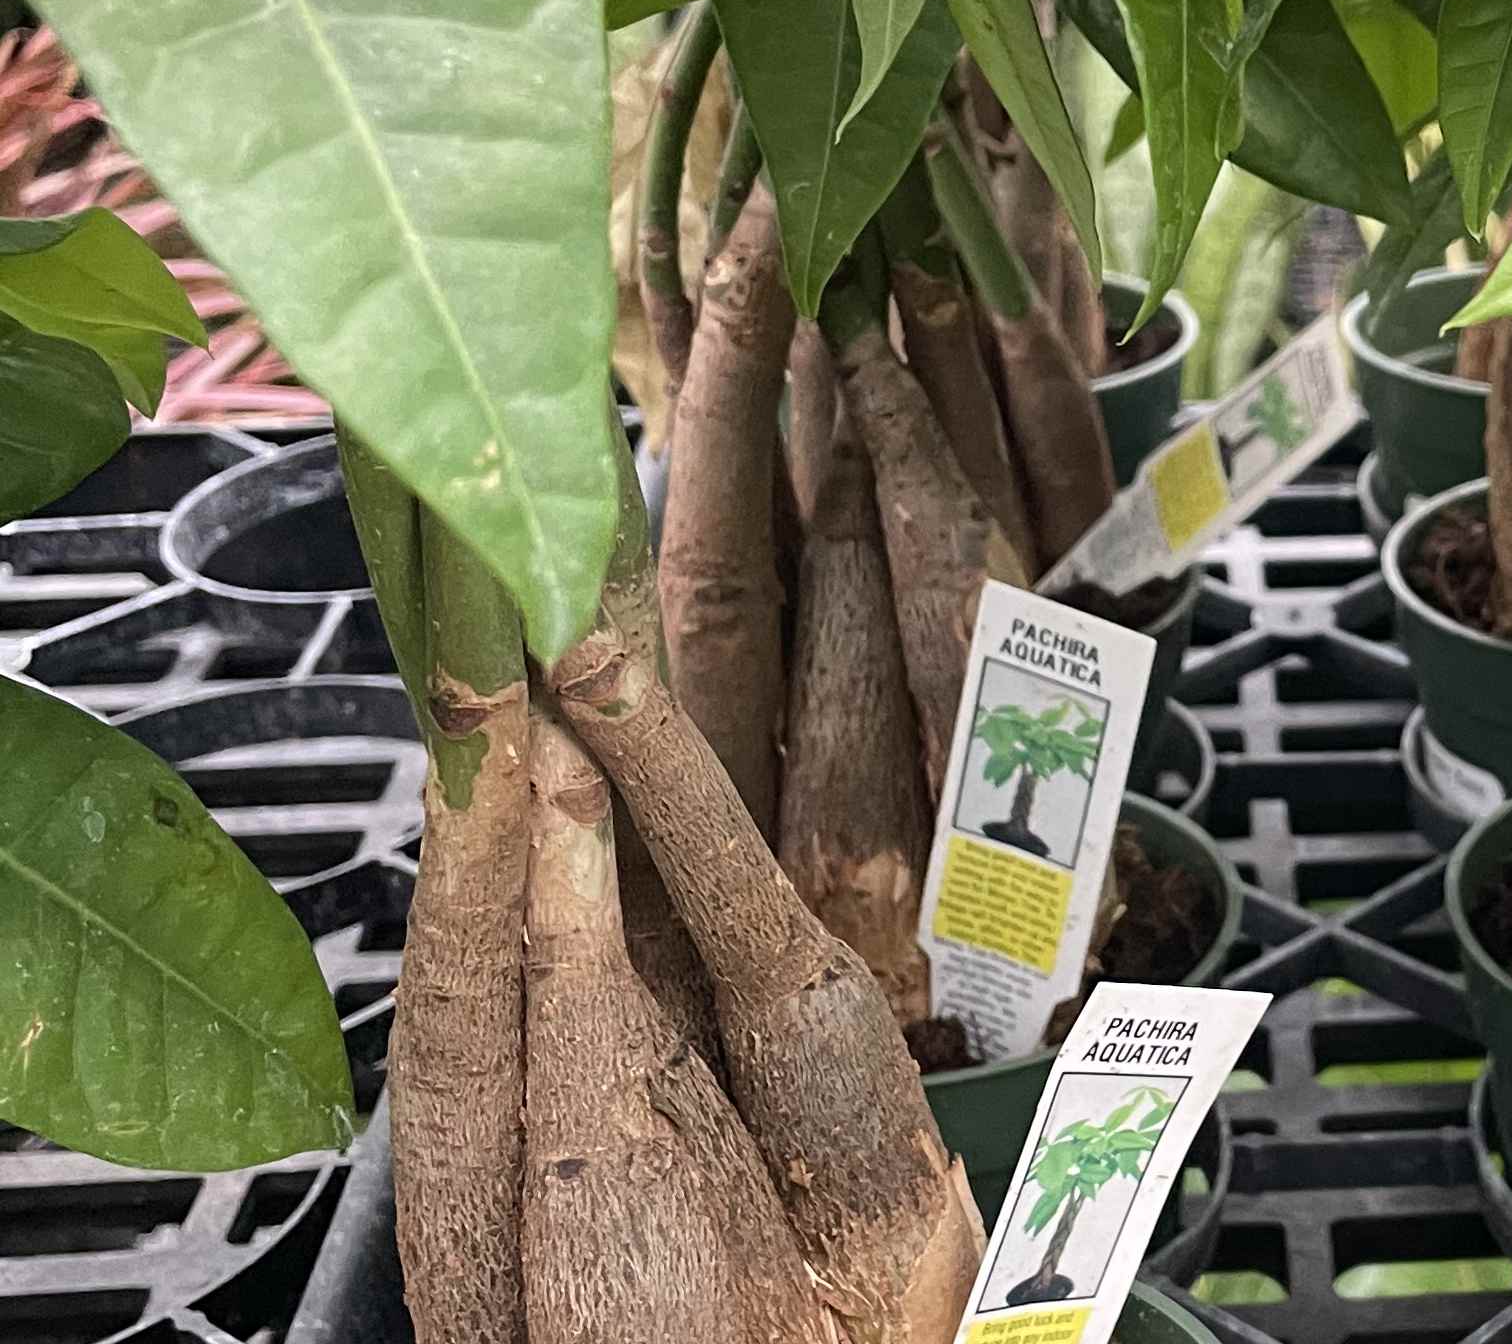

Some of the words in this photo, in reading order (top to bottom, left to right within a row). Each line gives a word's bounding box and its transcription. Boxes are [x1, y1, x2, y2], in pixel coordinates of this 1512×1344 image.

[1012, 618, 1098, 663] PACHIRA
[1000, 638, 1101, 686] AQUATICA
[1104, 1018, 1198, 1040] PACHIRA
[1082, 1041, 1192, 1065] AQUATICA
